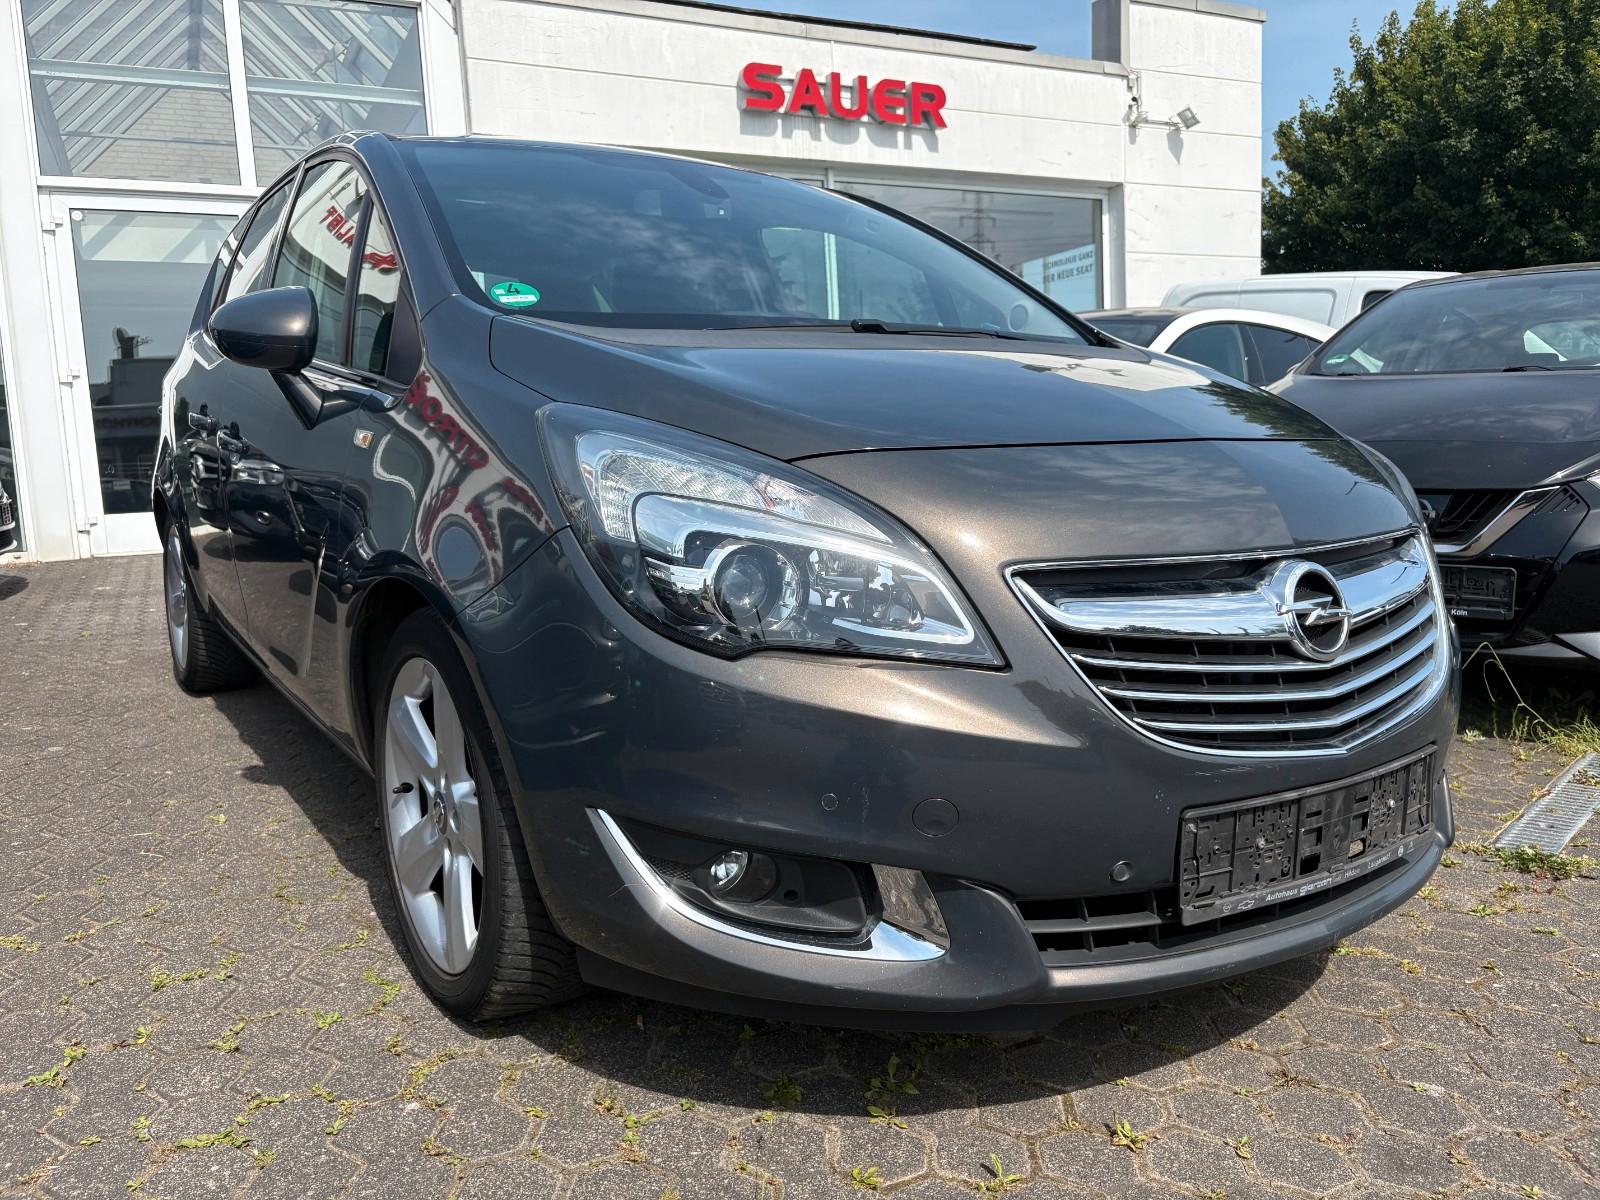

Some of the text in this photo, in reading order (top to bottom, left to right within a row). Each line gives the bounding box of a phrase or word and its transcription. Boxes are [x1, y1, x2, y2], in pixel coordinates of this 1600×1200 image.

[738, 62, 948, 129] SAUER
[1056, 266, 1075, 280] NEUE
[1075, 263, 1094, 276] SEAT
[507, 283, 520, 295] 4
[1451, 608, 1468, 616] Köln
[1265, 888, 1298, 902] Autohaus
